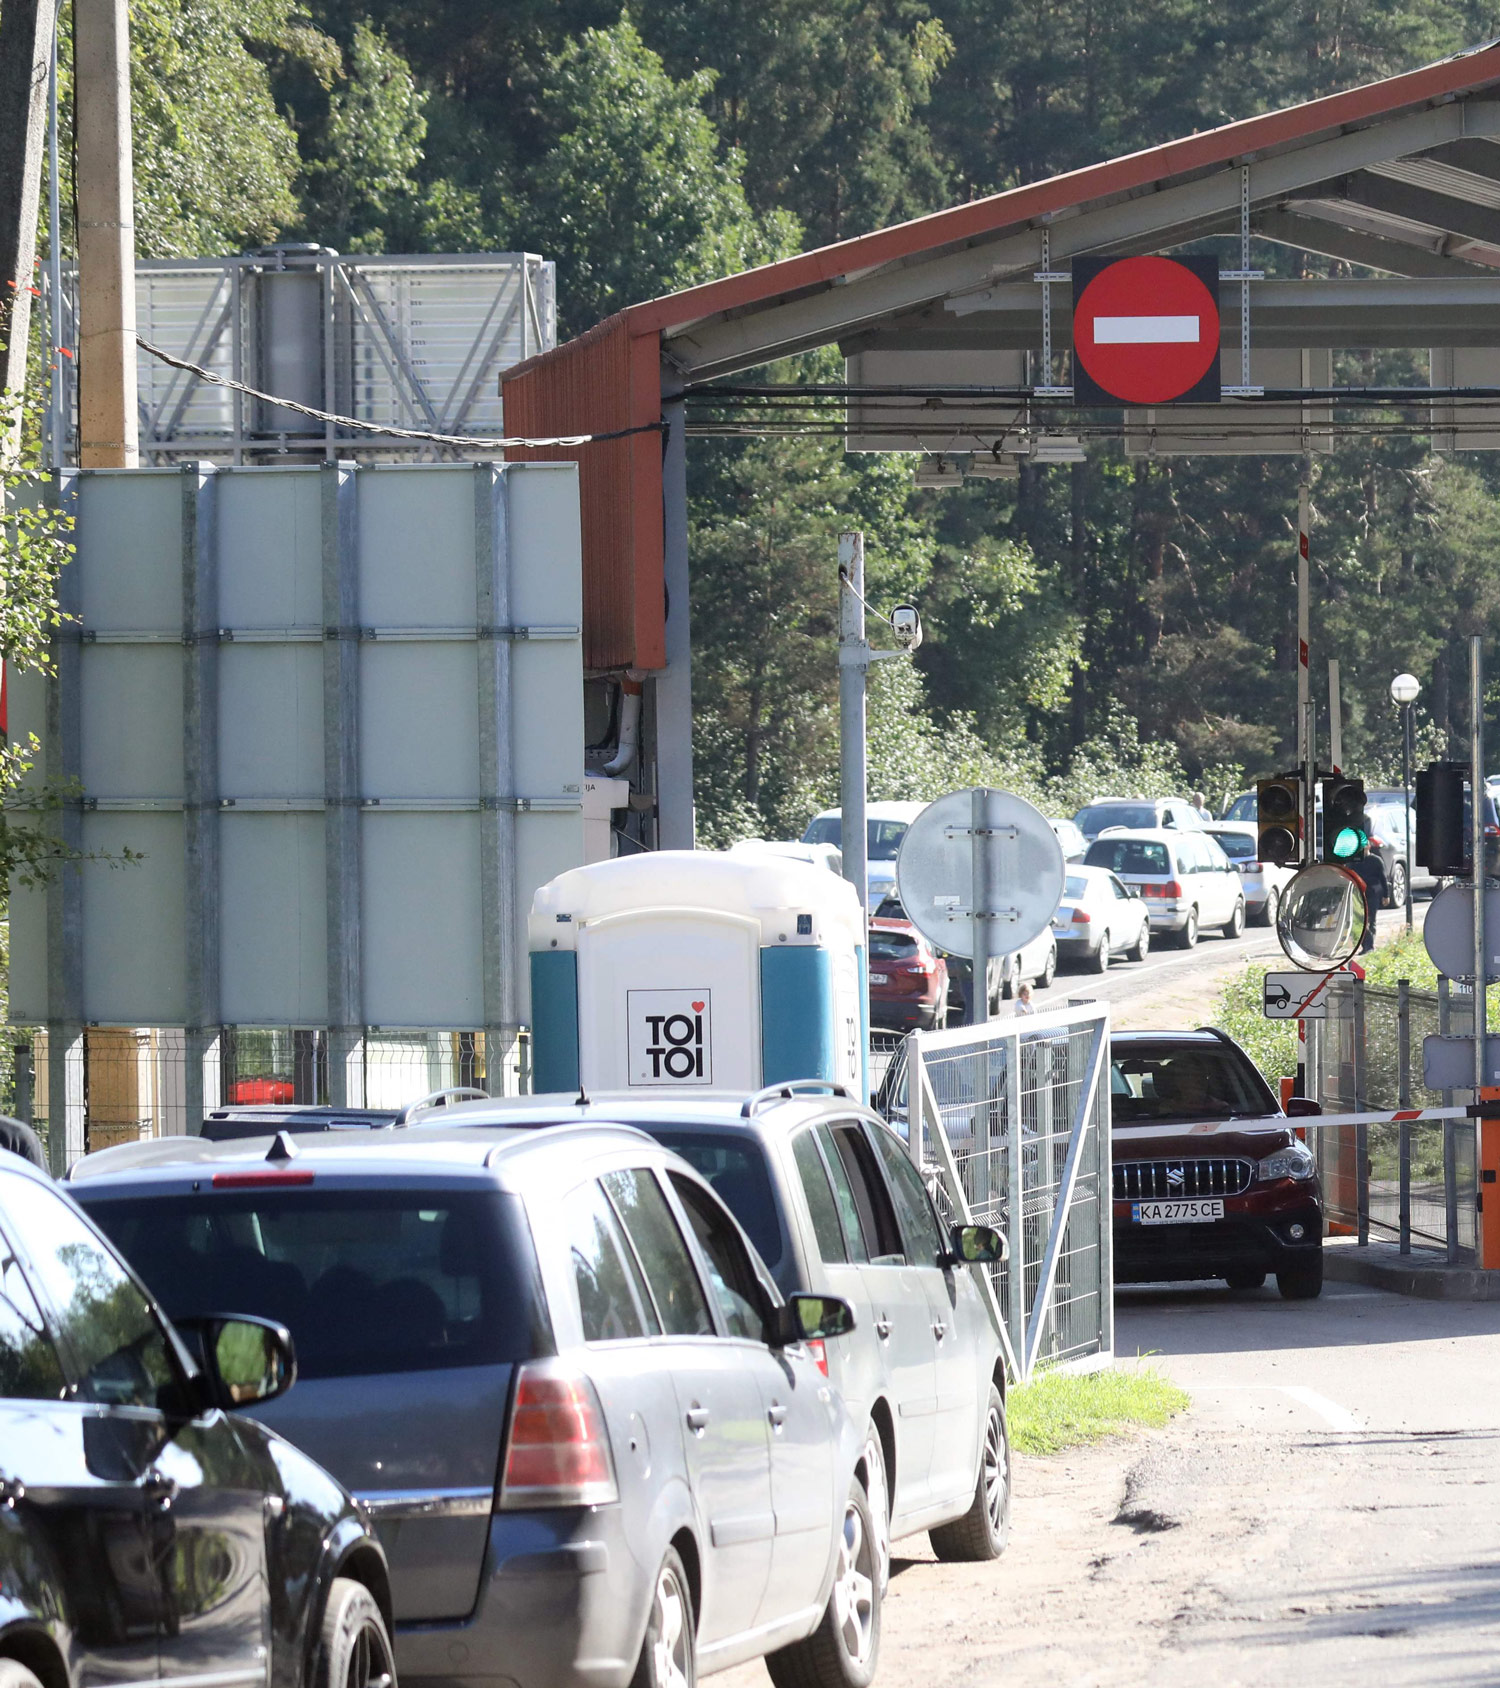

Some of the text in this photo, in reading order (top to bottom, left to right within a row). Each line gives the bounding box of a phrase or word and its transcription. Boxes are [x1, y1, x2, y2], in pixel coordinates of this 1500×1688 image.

[645, 1014, 703, 1046] TOI
[646, 1046, 704, 1078] TOI
[1164, 1203, 1198, 1218] 2775
